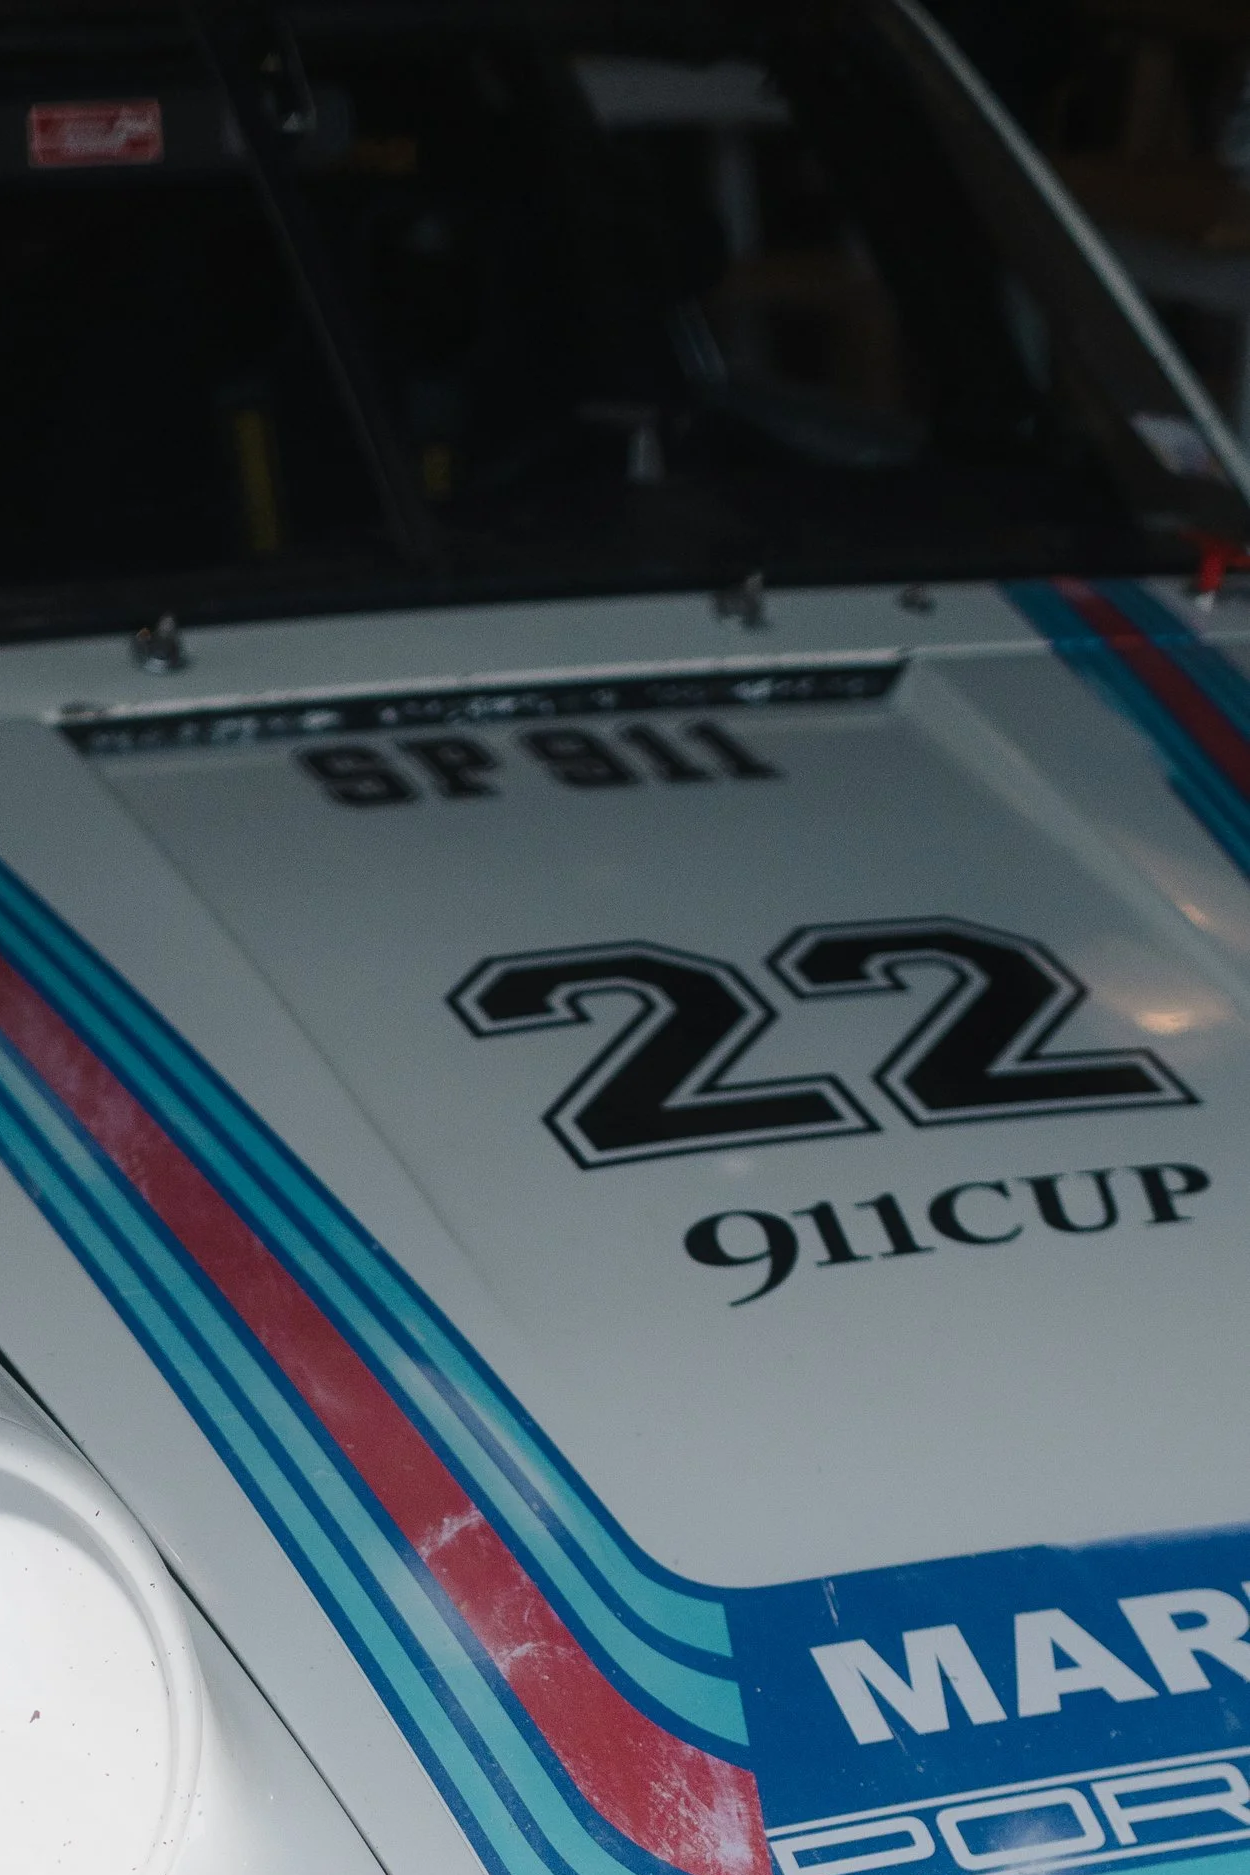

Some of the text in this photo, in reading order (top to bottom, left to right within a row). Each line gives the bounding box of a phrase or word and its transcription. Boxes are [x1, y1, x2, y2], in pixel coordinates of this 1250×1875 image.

[518, 720, 781, 788] 911
[447, 914, 1202, 1170] 22
[684, 1162, 1211, 1307] 911CUP
[808, 1580, 1250, 1746] MAR
